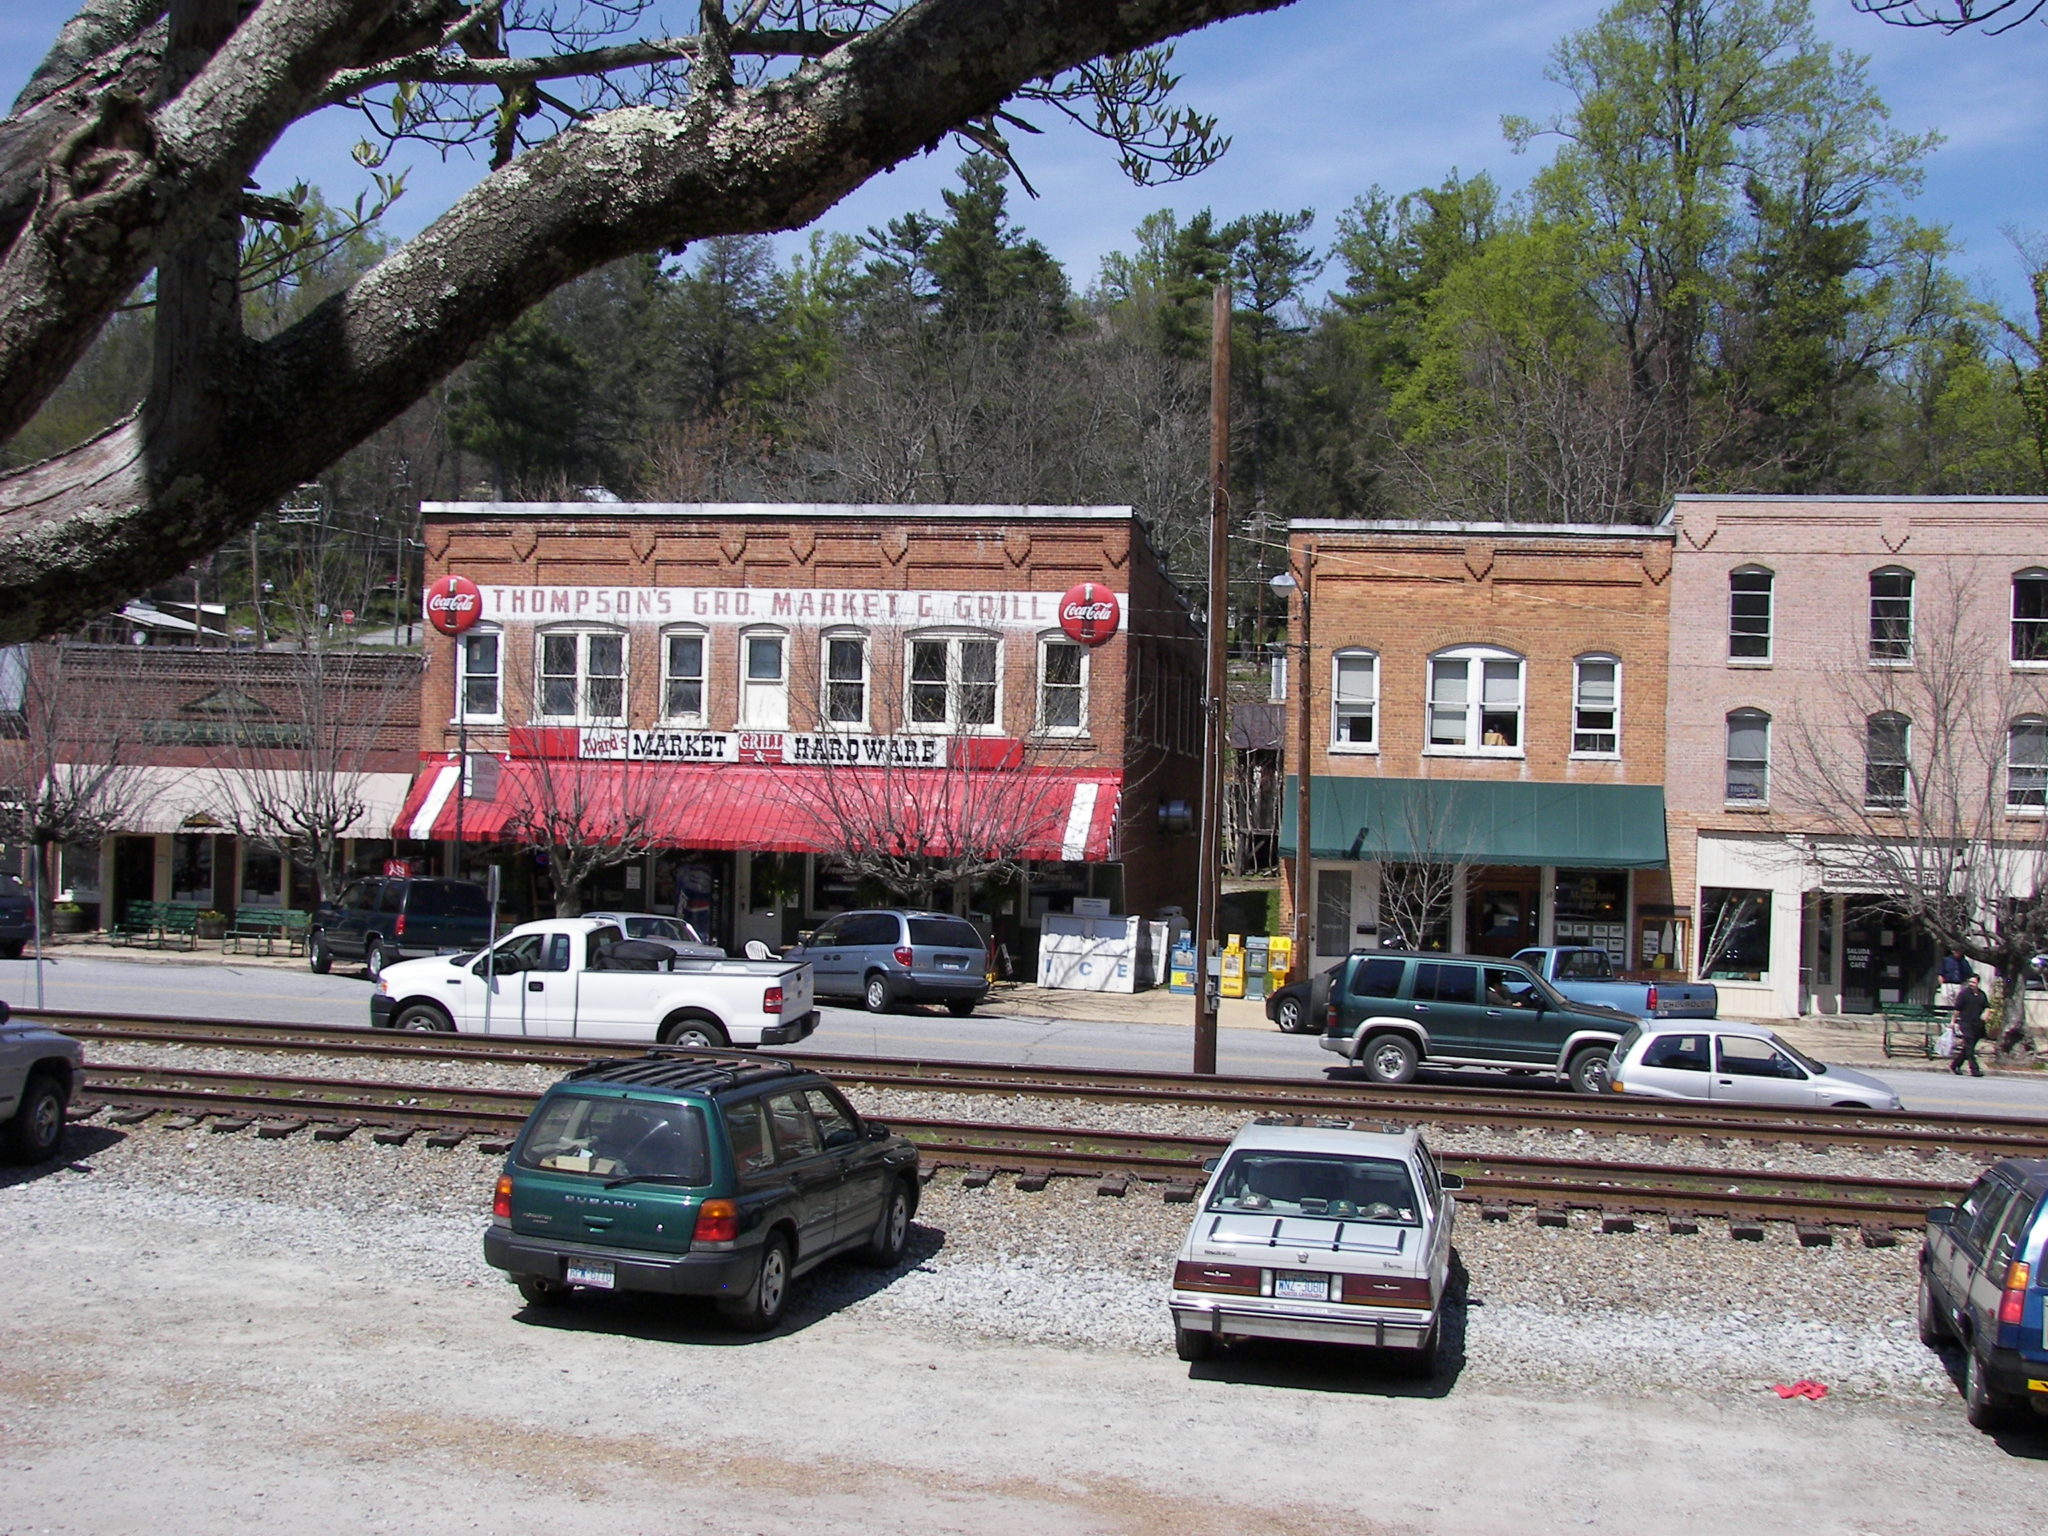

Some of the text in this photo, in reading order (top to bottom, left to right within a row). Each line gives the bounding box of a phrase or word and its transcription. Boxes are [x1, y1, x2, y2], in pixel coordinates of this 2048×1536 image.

[493, 589, 671, 614] THOMPSON'S
[771, 592, 899, 617] MARKET
[956, 595, 1047, 620] GRILL
[633, 734, 727, 758] MARKET
[739, 733, 783, 750] GRILL
[794, 738, 935, 762] HARDWARE
[1045, 958, 1128, 979] ICE
[565, 1195, 637, 1209] SUBARU
